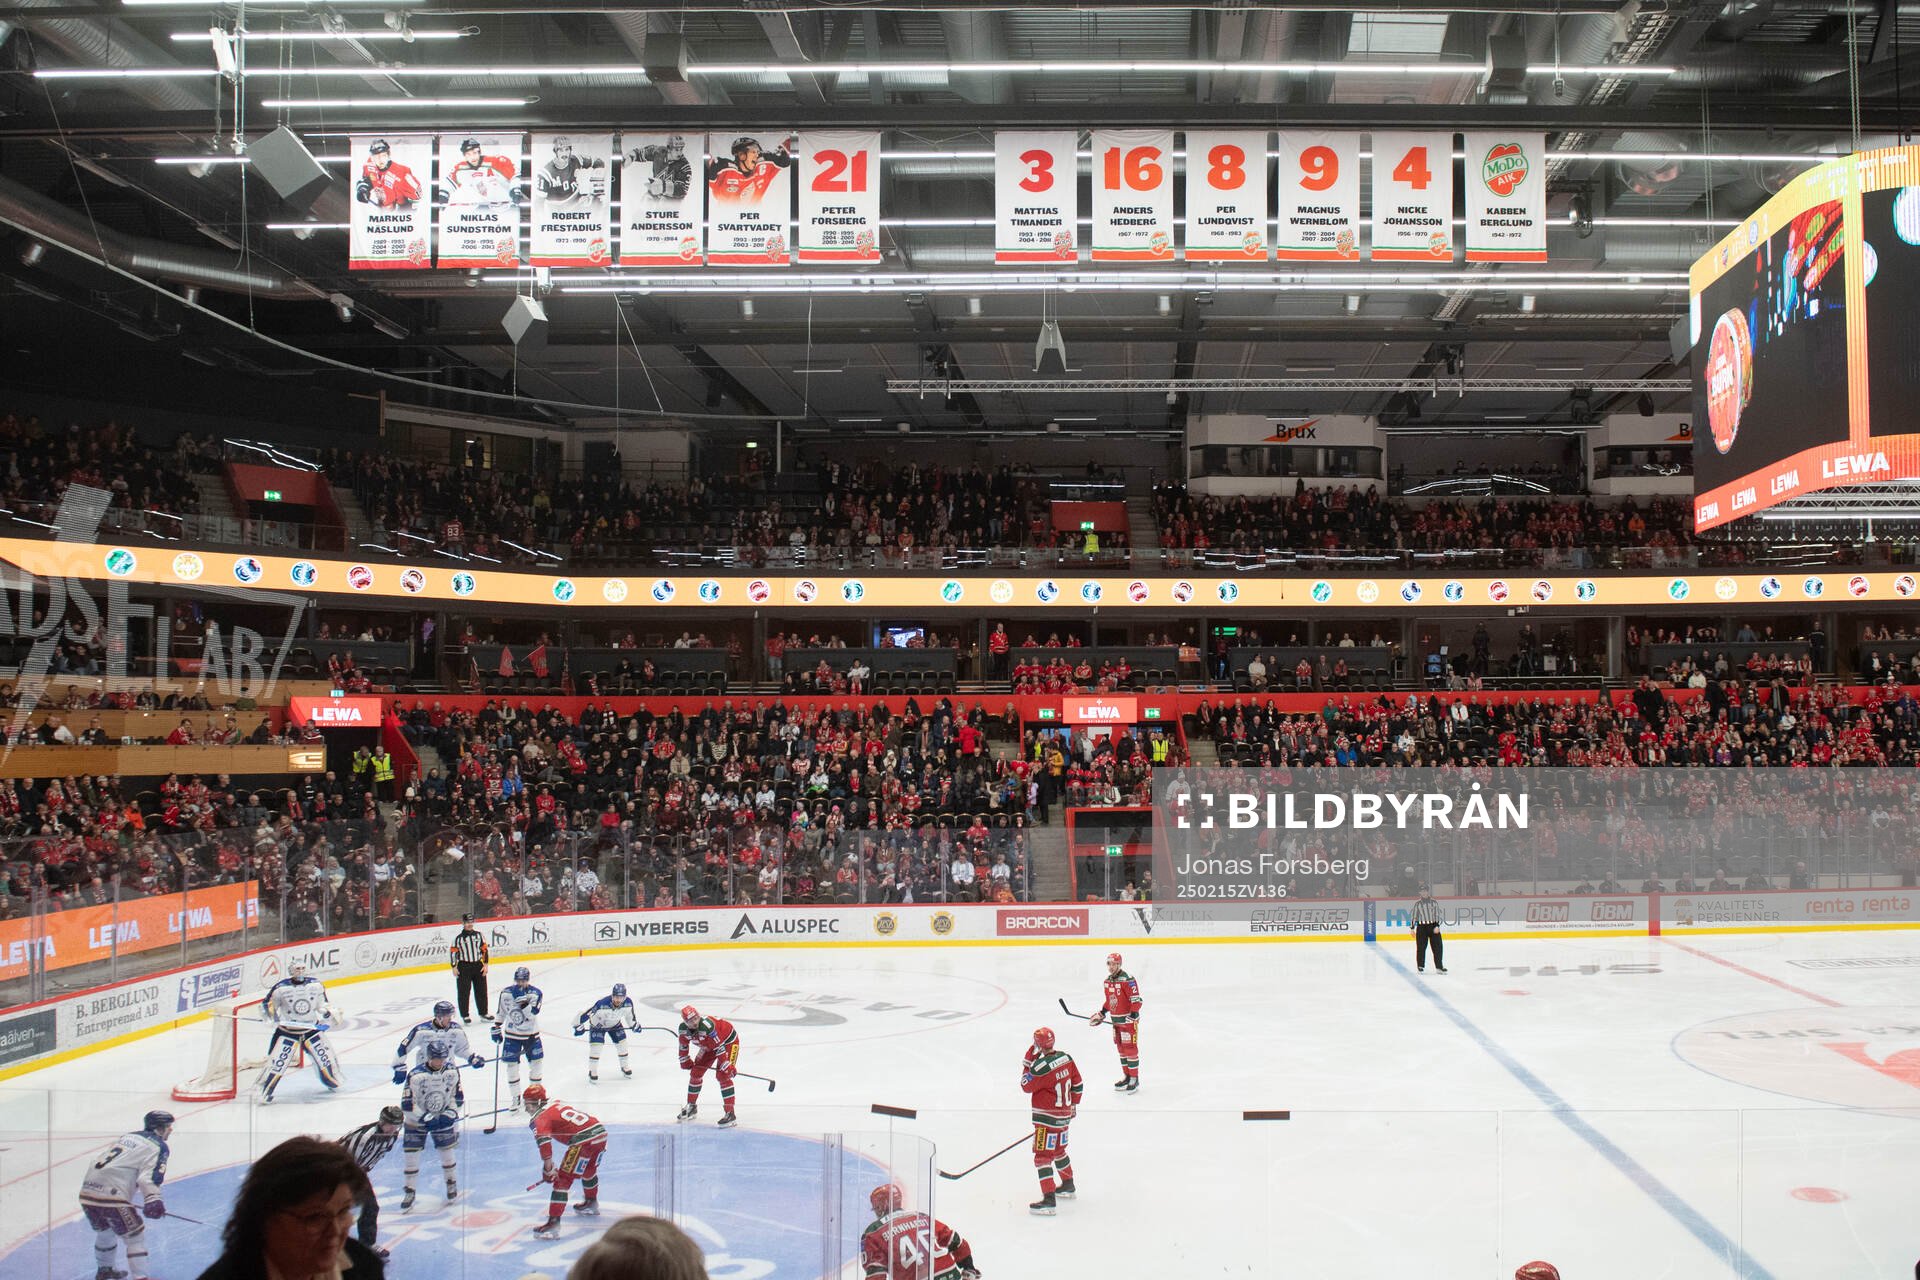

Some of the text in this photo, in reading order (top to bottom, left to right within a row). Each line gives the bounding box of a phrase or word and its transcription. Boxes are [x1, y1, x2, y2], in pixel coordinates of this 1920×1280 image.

[812, 149, 867, 192] 21
[1019, 149, 1054, 193] 3
[1104, 146, 1163, 192] 16
[1207, 144, 1246, 191] 8
[1299, 145, 1339, 192] 9
[1393, 146, 1432, 190] 4
[1487, 157, 1524, 176] MoDo
[1497, 174, 1517, 186] AIK
[369, 215, 412, 223] MARKUS
[460, 214, 498, 222] NIKLAS
[552, 212, 591, 220] ROBERT
[645, 211, 679, 219] STURE
[811, 217, 866, 226] FORSBERG
[1010, 218, 1062, 226] TIMANDER
[1110, 218, 1156, 226] HEDBERG
[1198, 217, 1254, 226] LUNDQVIST
[1384, 218, 1442, 226] JOHANSSON
[447, 224, 511, 233] SUNDSTRÖM
[541, 224, 602, 233] FRESTADIUS
[631, 223, 693, 231] ANDERSSON
[718, 224, 781, 232] SVARTVADET
[1277, 423, 1316, 439] Brux
[1822, 452, 1890, 478] LEWA
[1770, 470, 1800, 496] LEWA
[1731, 487, 1757, 510] LEWA
[1696, 501, 1719, 524] LEWA
[312, 707, 362, 721] LEWA
[1079, 707, 1121, 719] LEWA
[1528, 903, 1569, 921] ÖBM
[1592, 902, 1633, 920] ÖBM
[1697, 899, 1765, 911] KVALITETS
[1806, 897, 1854, 914] renta
[1862, 896, 1911, 912] renta
[1006, 916, 1081, 929] BRORCON
[1250, 906, 1350, 923] SJÖBERGS
[1697, 911, 1781, 923] PERSIENNER
[89, 920, 141, 949] LEWA
[625, 921, 709, 938] NYBERGS
[761, 918, 839, 935] ALUSPEC
[1250, 923, 1349, 932] ENTREPRENAD
[201, 967, 241, 987] svenska
[214, 984, 230, 998] tält
[76, 986, 159, 1020] B. BERGLUND
[76, 1003, 159, 1038] Entreprenad AB
[1055, 1078, 1072, 1107] 10
[561, 1109, 590, 1126] 8
